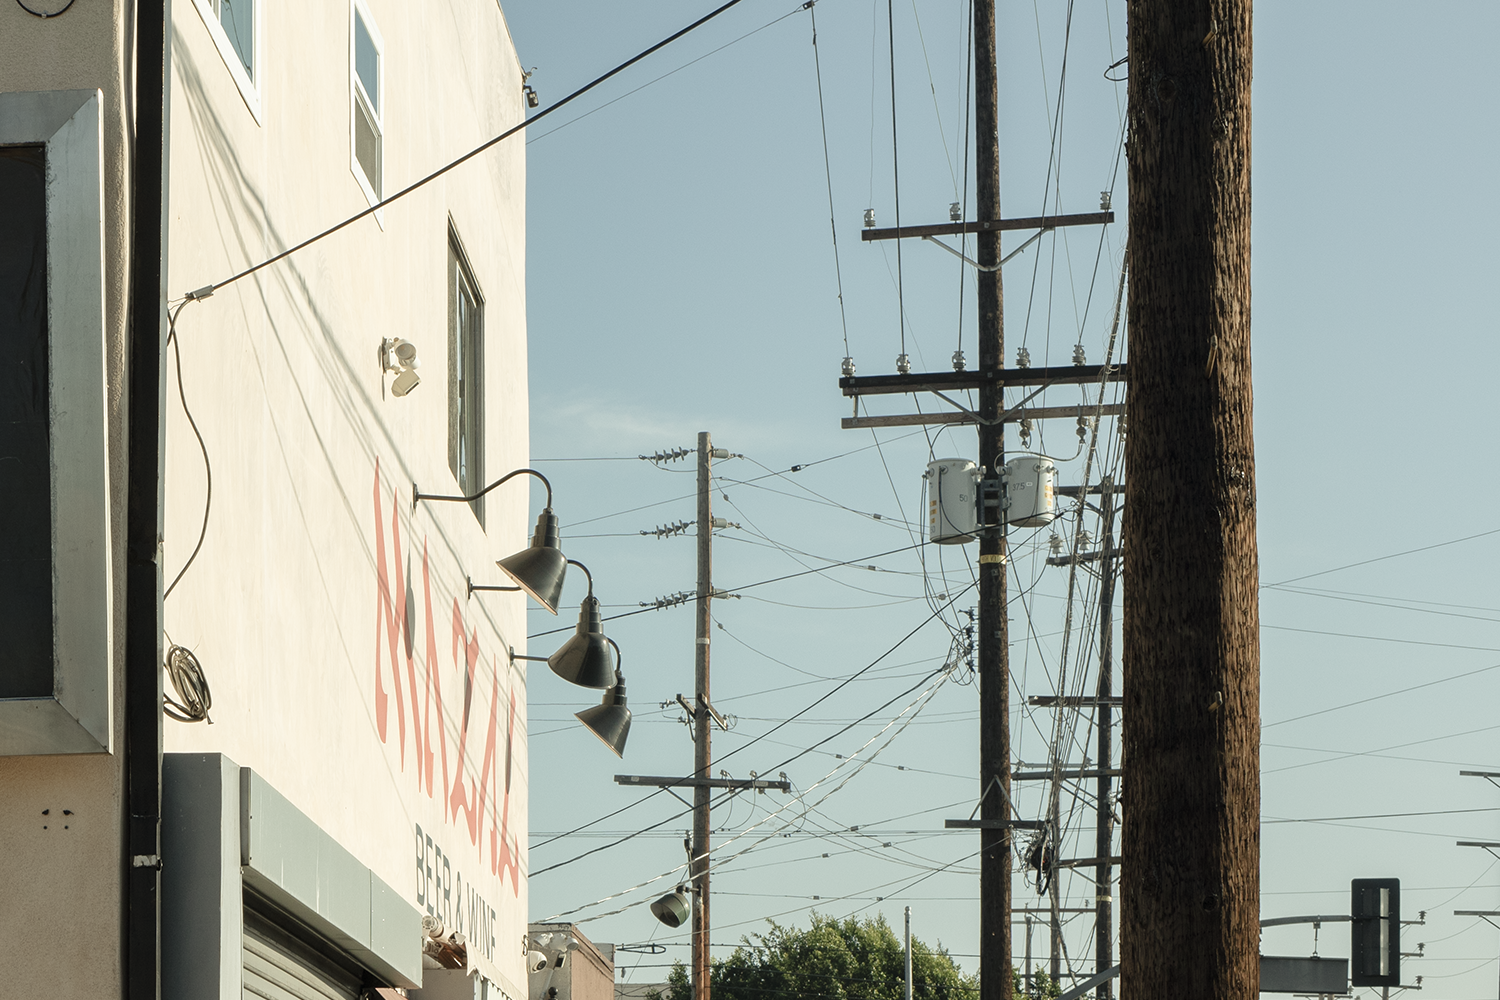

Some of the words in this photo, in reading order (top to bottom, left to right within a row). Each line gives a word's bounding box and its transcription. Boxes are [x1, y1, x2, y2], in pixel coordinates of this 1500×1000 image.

[959, 494, 968, 502] 50
[373, 455, 520, 899] MAZAL
[415, 822, 451, 929] BEER
[455, 871, 463, 934] &
